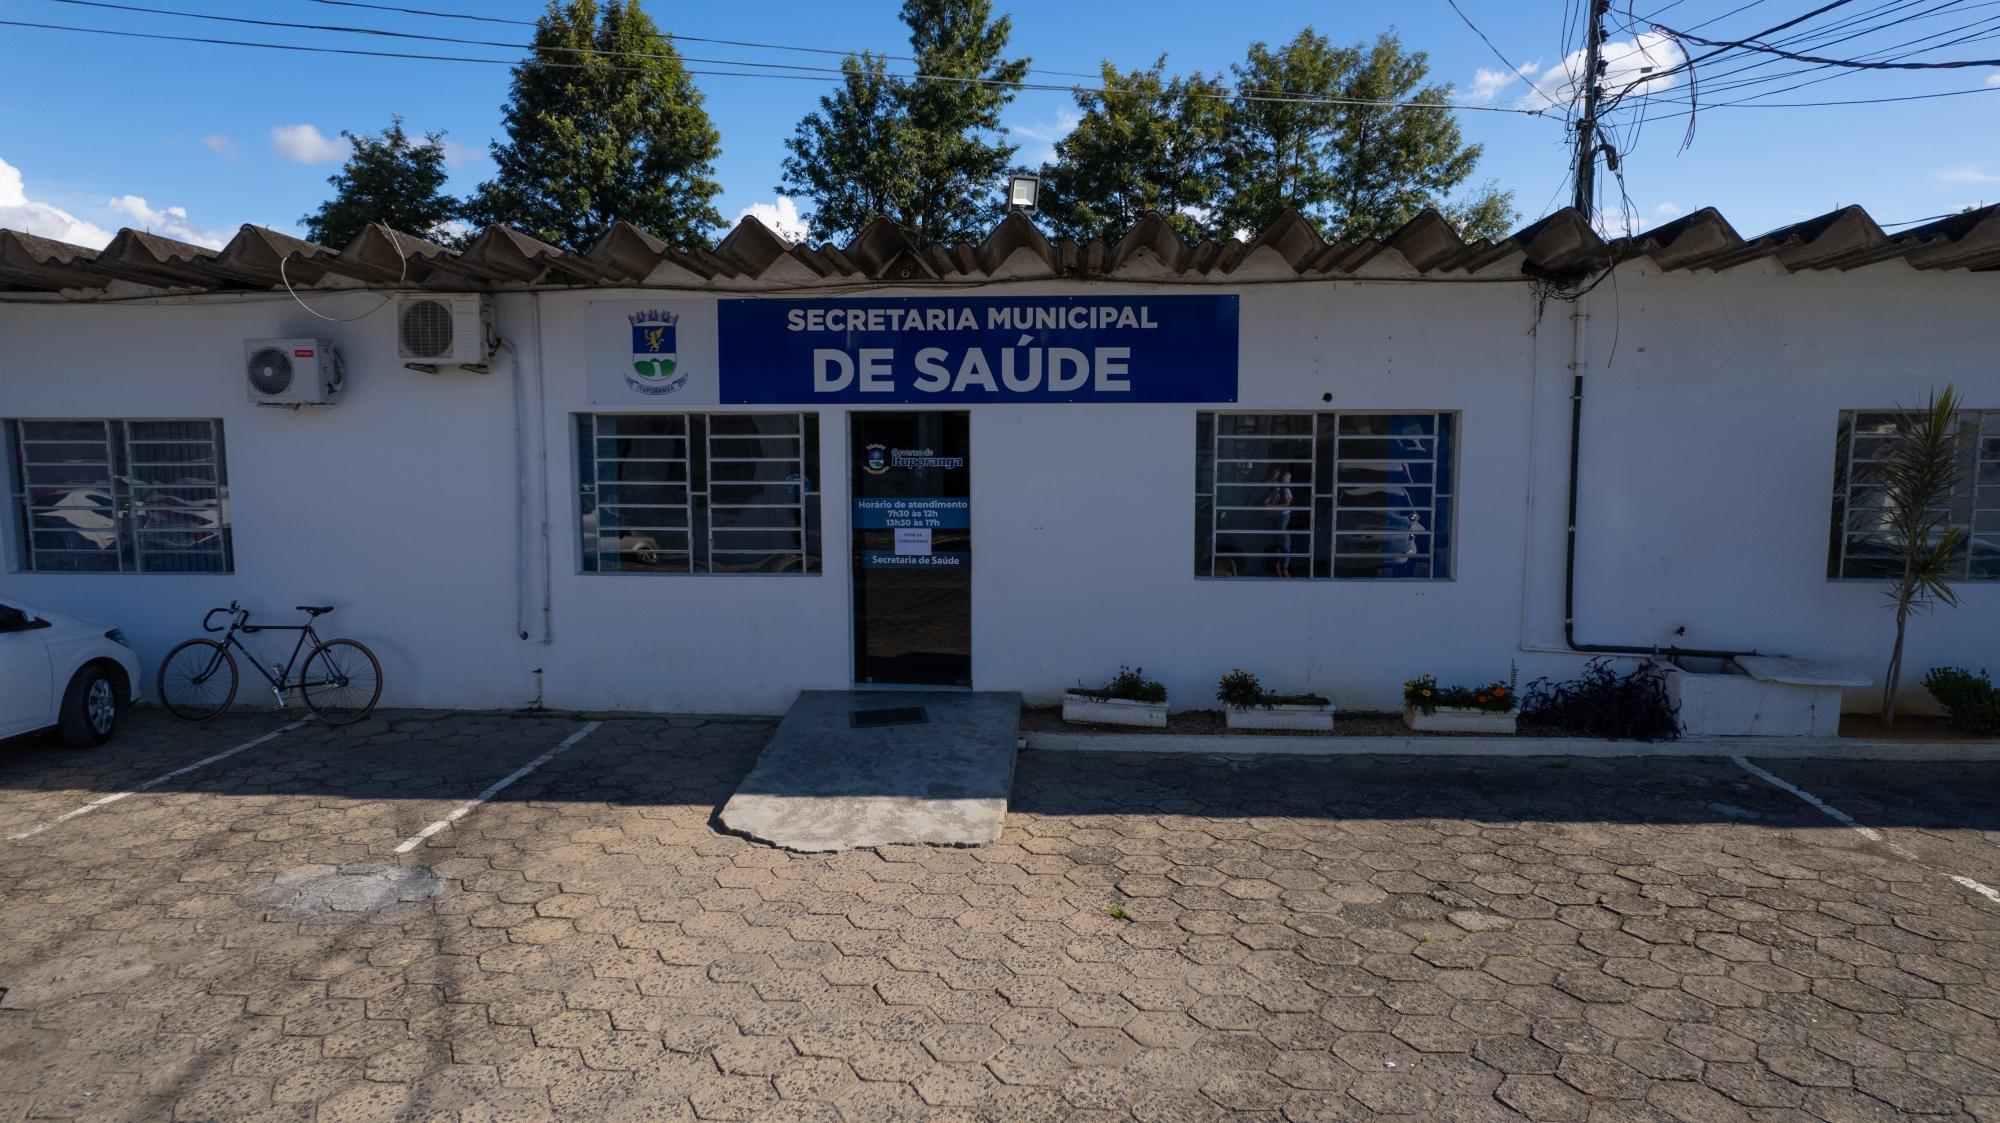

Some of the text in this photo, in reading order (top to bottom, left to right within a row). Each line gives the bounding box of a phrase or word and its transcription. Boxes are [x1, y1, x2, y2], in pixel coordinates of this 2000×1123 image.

[787, 306, 1158, 331] SECRETARIA MUNICIPAL
[813, 333, 1131, 393] DE SAÚDE
[890, 456, 963, 469] Ituporanga
[858, 501, 968, 509] Horário de atendimento
[887, 510, 938, 518] 7h30 às 12h
[886, 519, 940, 527] 13h30 às 17h
[872, 556, 960, 565] Secretaria de Saúde
